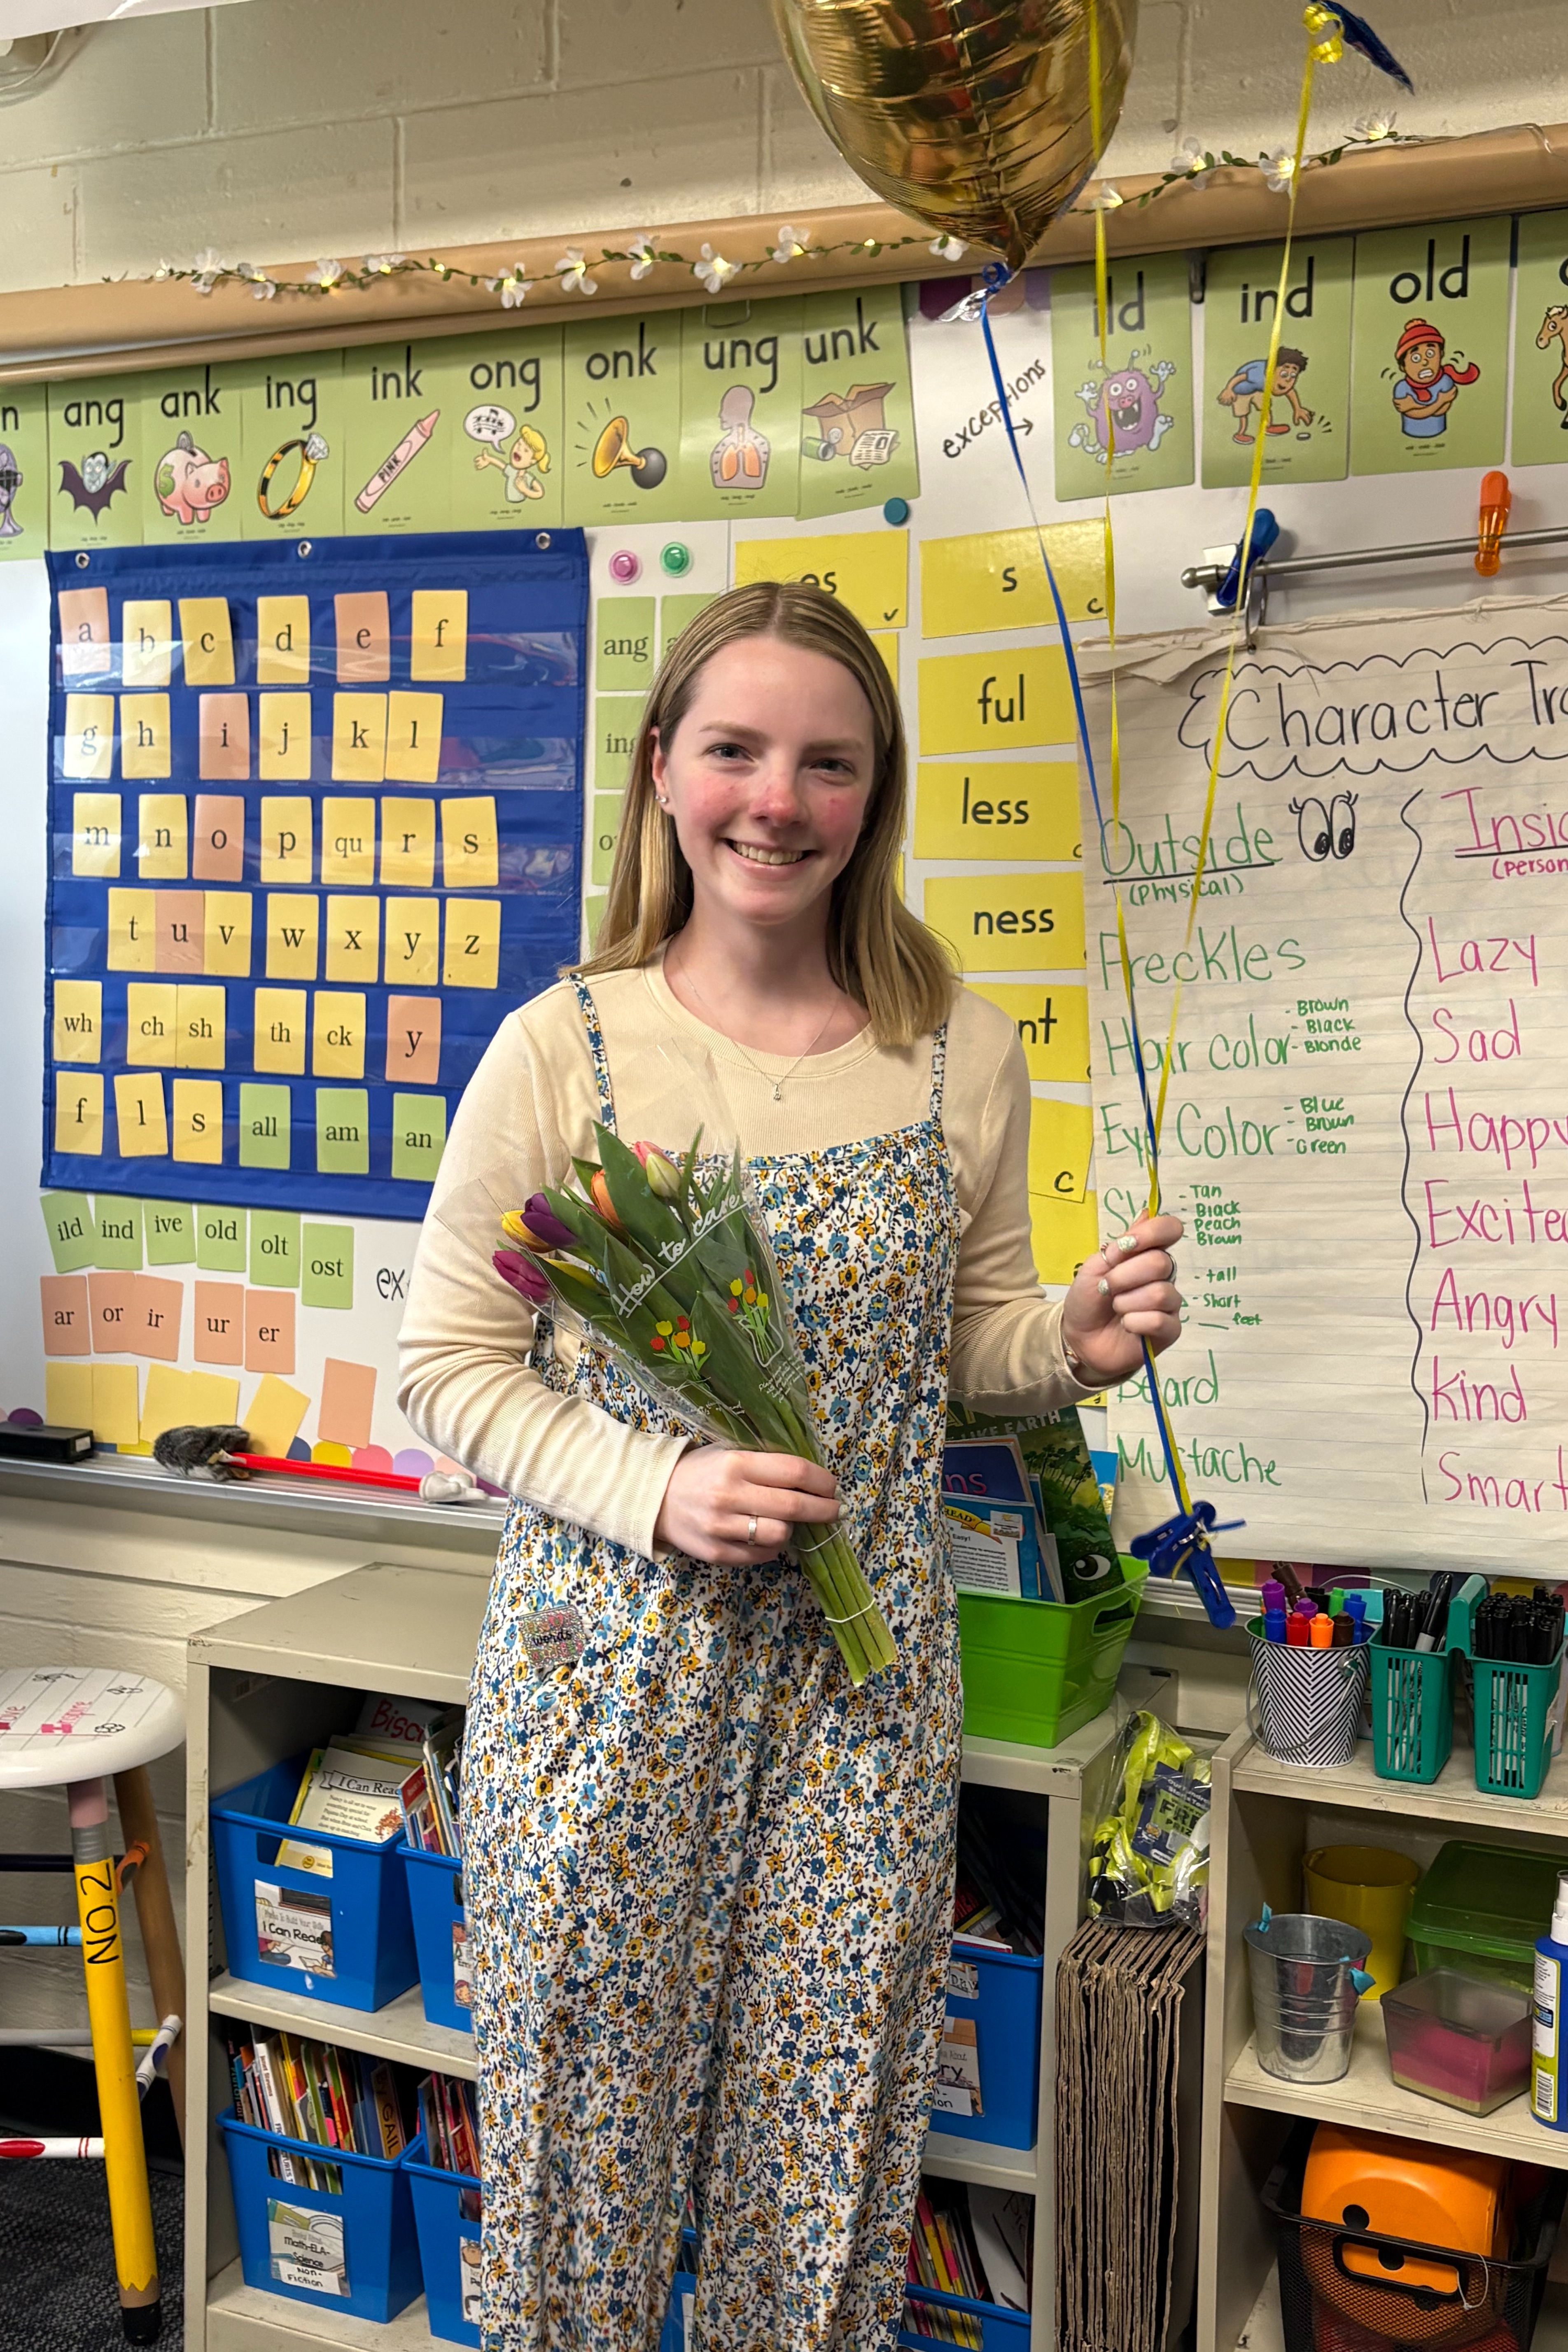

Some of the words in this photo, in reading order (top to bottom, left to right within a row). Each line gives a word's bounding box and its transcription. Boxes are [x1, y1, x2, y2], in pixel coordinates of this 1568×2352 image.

[1240, 256, 1314, 323] ind
[1389, 234, 1470, 305] old
[586, 322, 658, 380] onk
[804, 297, 881, 364] unk
[161, 365, 222, 418] ank
[371, 345, 423, 400] ink
[470, 357, 541, 412] ong
[703, 336, 778, 394] ung
[64, 398, 124, 448] ang
[266, 376, 317, 430] ing
[378, 454, 402, 483] PINK
[1002, 567, 1017, 592] s
[78, 621, 93, 642] a
[139, 628, 155, 653] b
[201, 632, 215, 653] c
[275, 624, 294, 652] d
[356, 628, 371, 649] e
[434, 619, 449, 647] f
[603, 636, 649, 662] ang
[977, 673, 1025, 725] ful
[1225, 670, 1500, 750] Character
[81, 725, 98, 756] g
[137, 721, 155, 747] h
[220, 723, 229, 747] i
[278, 723, 289, 756] j
[350, 721, 370, 749] k
[962, 777, 1029, 824] less
[84, 826, 110, 846] m
[155, 828, 172, 848] n
[211, 829, 227, 849] o
[279, 831, 296, 859] p
[335, 836, 362, 858] qu
[402, 833, 416, 853] r
[463, 833, 479, 854] s
[1101, 803, 1283, 876] Outside
[129, 915, 139, 941] t
[171, 922, 189, 942] u
[219, 924, 235, 945] v
[280, 928, 306, 947] w
[344, 930, 362, 950] x
[404, 932, 421, 959] y
[464, 935, 480, 954] z
[973, 909, 1054, 935] ness
[1429, 916, 1538, 987] Lazy
[64, 1013, 93, 1032] wh
[140, 1016, 164, 1036] ch
[189, 1018, 213, 1038] sh
[270, 1022, 291, 1043] th
[327, 1025, 353, 1046] ck
[405, 1030, 423, 1057] y
[1433, 998, 1521, 1063] Sad
[75, 1097, 88, 1124] f
[191, 1113, 205, 1132] s
[252, 1117, 277, 1137] all
[325, 1124, 360, 1141] am
[405, 1132, 432, 1148] an
[1176, 1103, 1281, 1159] Color
[56, 1217, 84, 1241] ild
[101, 1220, 134, 1240] ind
[154, 1215, 183, 1233] ive
[205, 1219, 238, 1241] old
[261, 1235, 289, 1256] olt
[310, 1258, 344, 1277] ost
[612, 1263, 656, 1316] How
[658, 1238, 686, 1262] to
[54, 1310, 75, 1325] ar
[103, 1307, 124, 1322] or
[147, 1309, 164, 1328] ir
[207, 1317, 230, 1333] ur
[259, 1326, 280, 1342] er
[1430, 1267, 1558, 1350] Angry
[1004, 1409, 1061, 1434] EARTH
[1438, 1445, 1568, 1512] Smart
[347, 1778, 370, 1792] Can
[269, 1923, 292, 1938] Can
[382, 2102, 400, 2155] GAIL
